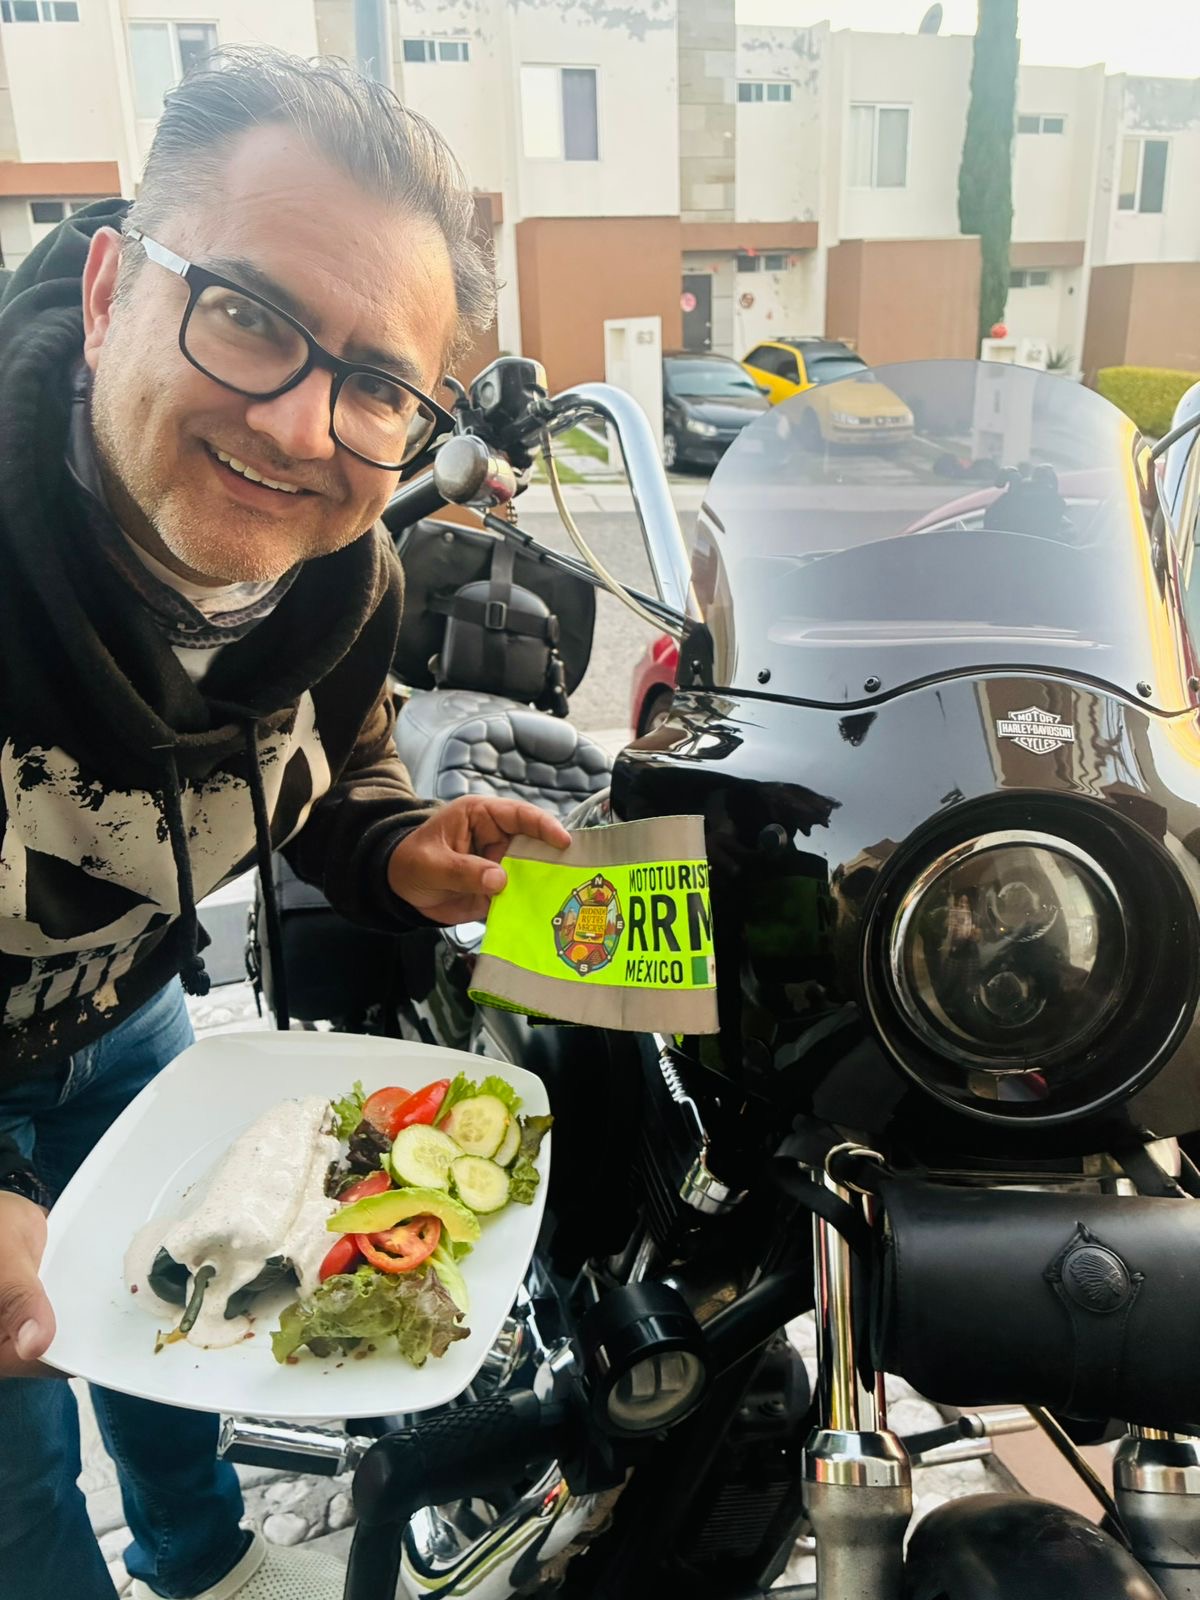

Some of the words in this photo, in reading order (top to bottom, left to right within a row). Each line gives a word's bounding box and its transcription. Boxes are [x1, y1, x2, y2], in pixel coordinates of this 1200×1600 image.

[637, 330, 655, 345] 63
[1017, 711, 1054, 724] MOTOR
[1002, 723, 1072, 738] HARLEY-DAVIDSON
[1020, 737, 1056, 751] CYCLES
[594, 877, 602, 885] N
[579, 963, 588, 972] S
[625, 955, 683, 984] MÉXICO
